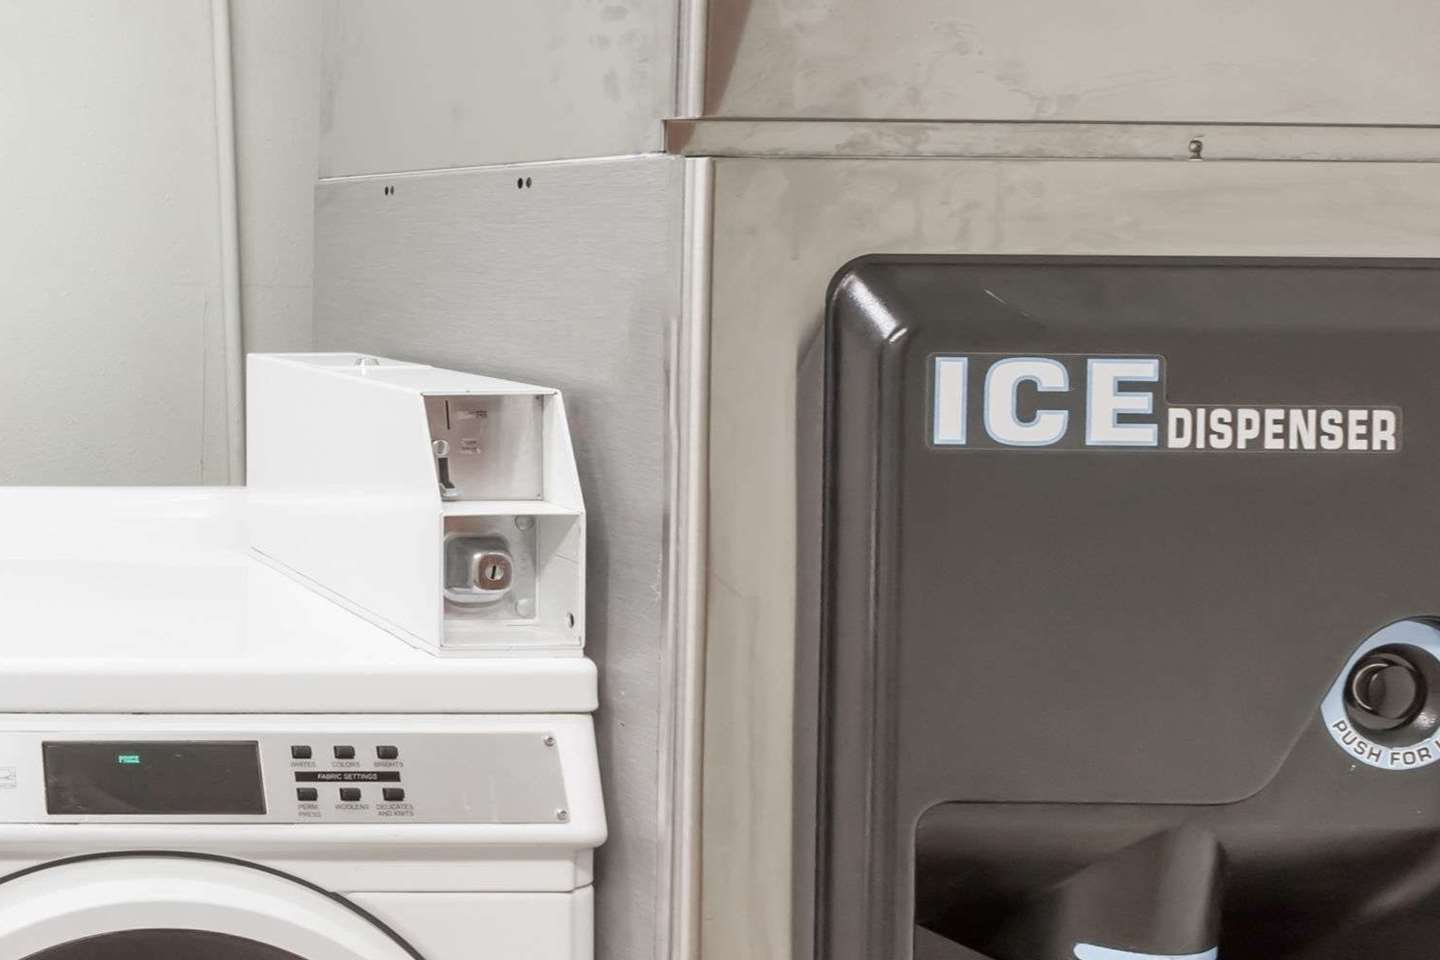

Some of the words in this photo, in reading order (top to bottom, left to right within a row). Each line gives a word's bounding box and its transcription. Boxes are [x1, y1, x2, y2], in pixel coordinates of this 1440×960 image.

[933, 356, 1161, 447] ICE
[1167, 407, 1397, 451] DISPENSER
[1332, 719, 1383, 763] PUSH
[1390, 747, 1433, 766] FOR
[317, 772, 342, 780] FABRIC
[343, 772, 378, 780] SETTINGS
